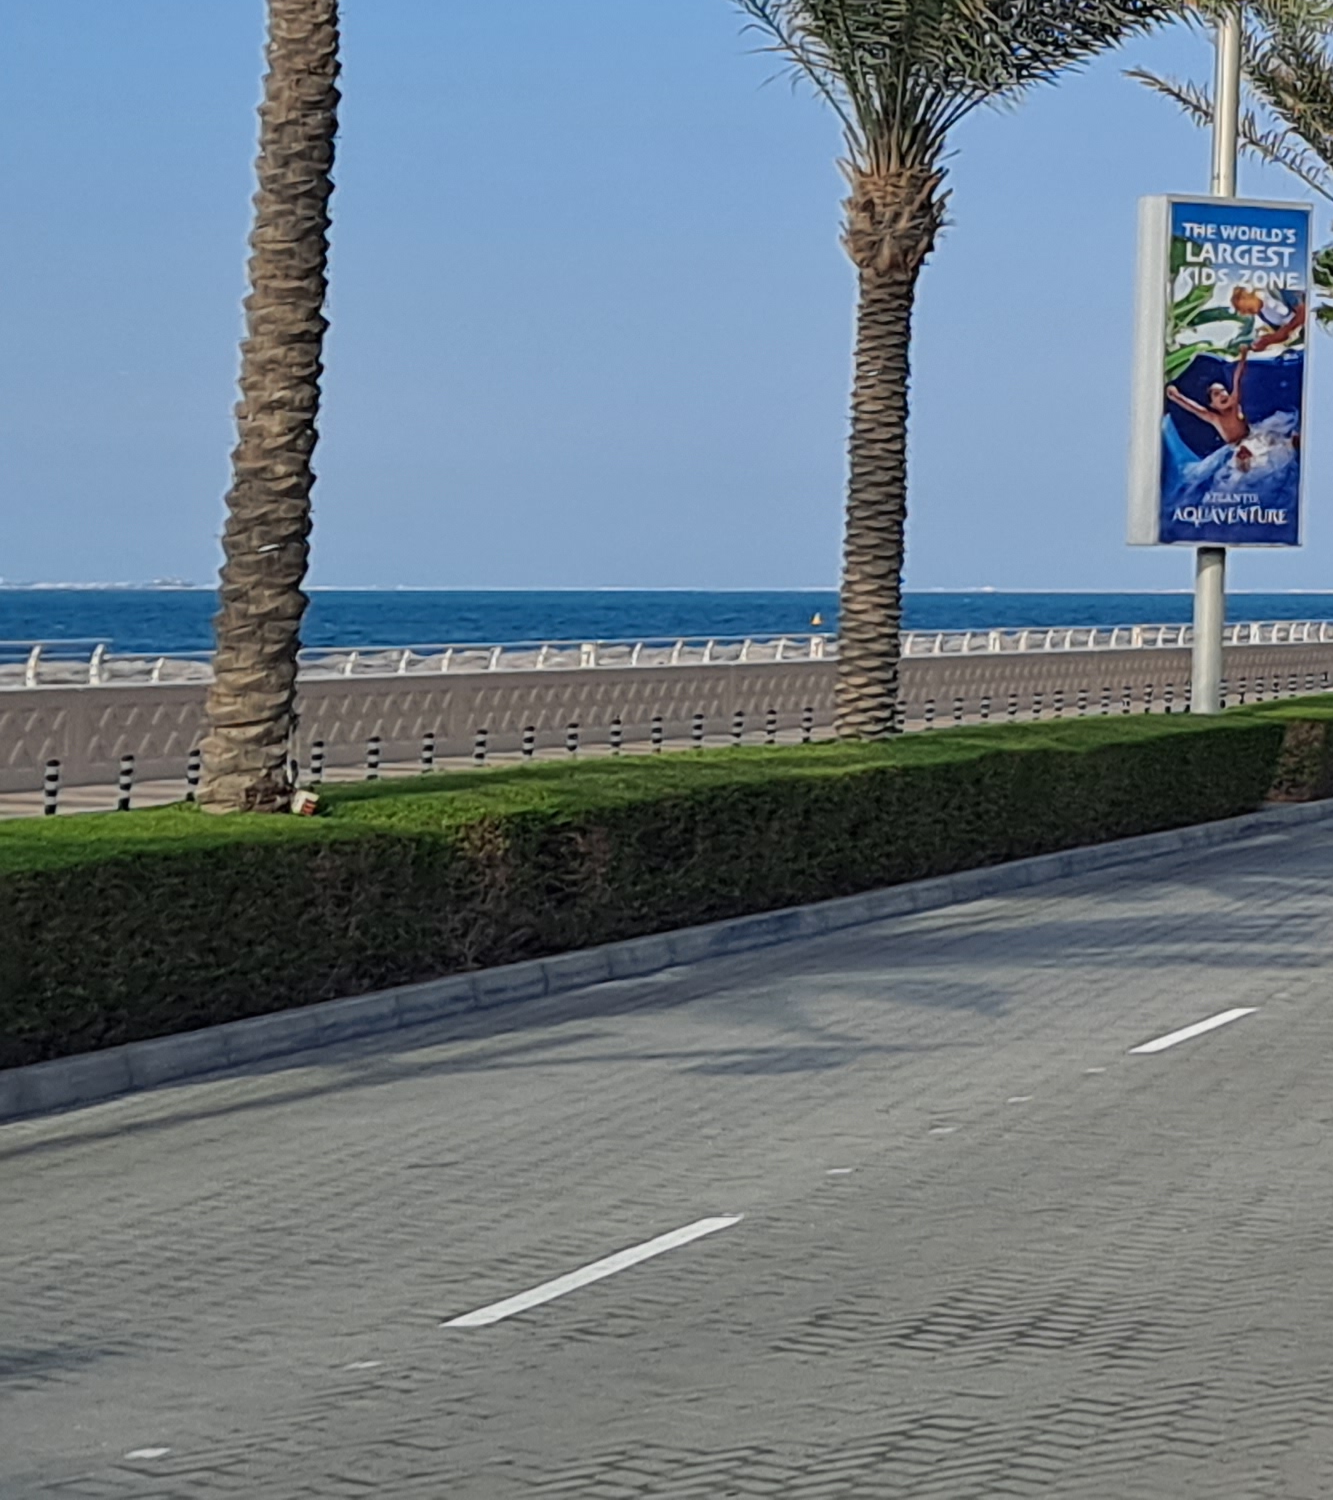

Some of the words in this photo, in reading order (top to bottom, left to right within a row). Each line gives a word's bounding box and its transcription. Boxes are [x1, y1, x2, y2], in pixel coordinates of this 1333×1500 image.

[1181, 222, 1217, 239] THE
[1220, 224, 1297, 244] WORLD'S
[1186, 241, 1296, 267] LARGEST
[1179, 266, 1229, 286] KIDS
[1239, 269, 1301, 290] ZONE
[1172, 505, 1289, 528] AQUAVENTURE
